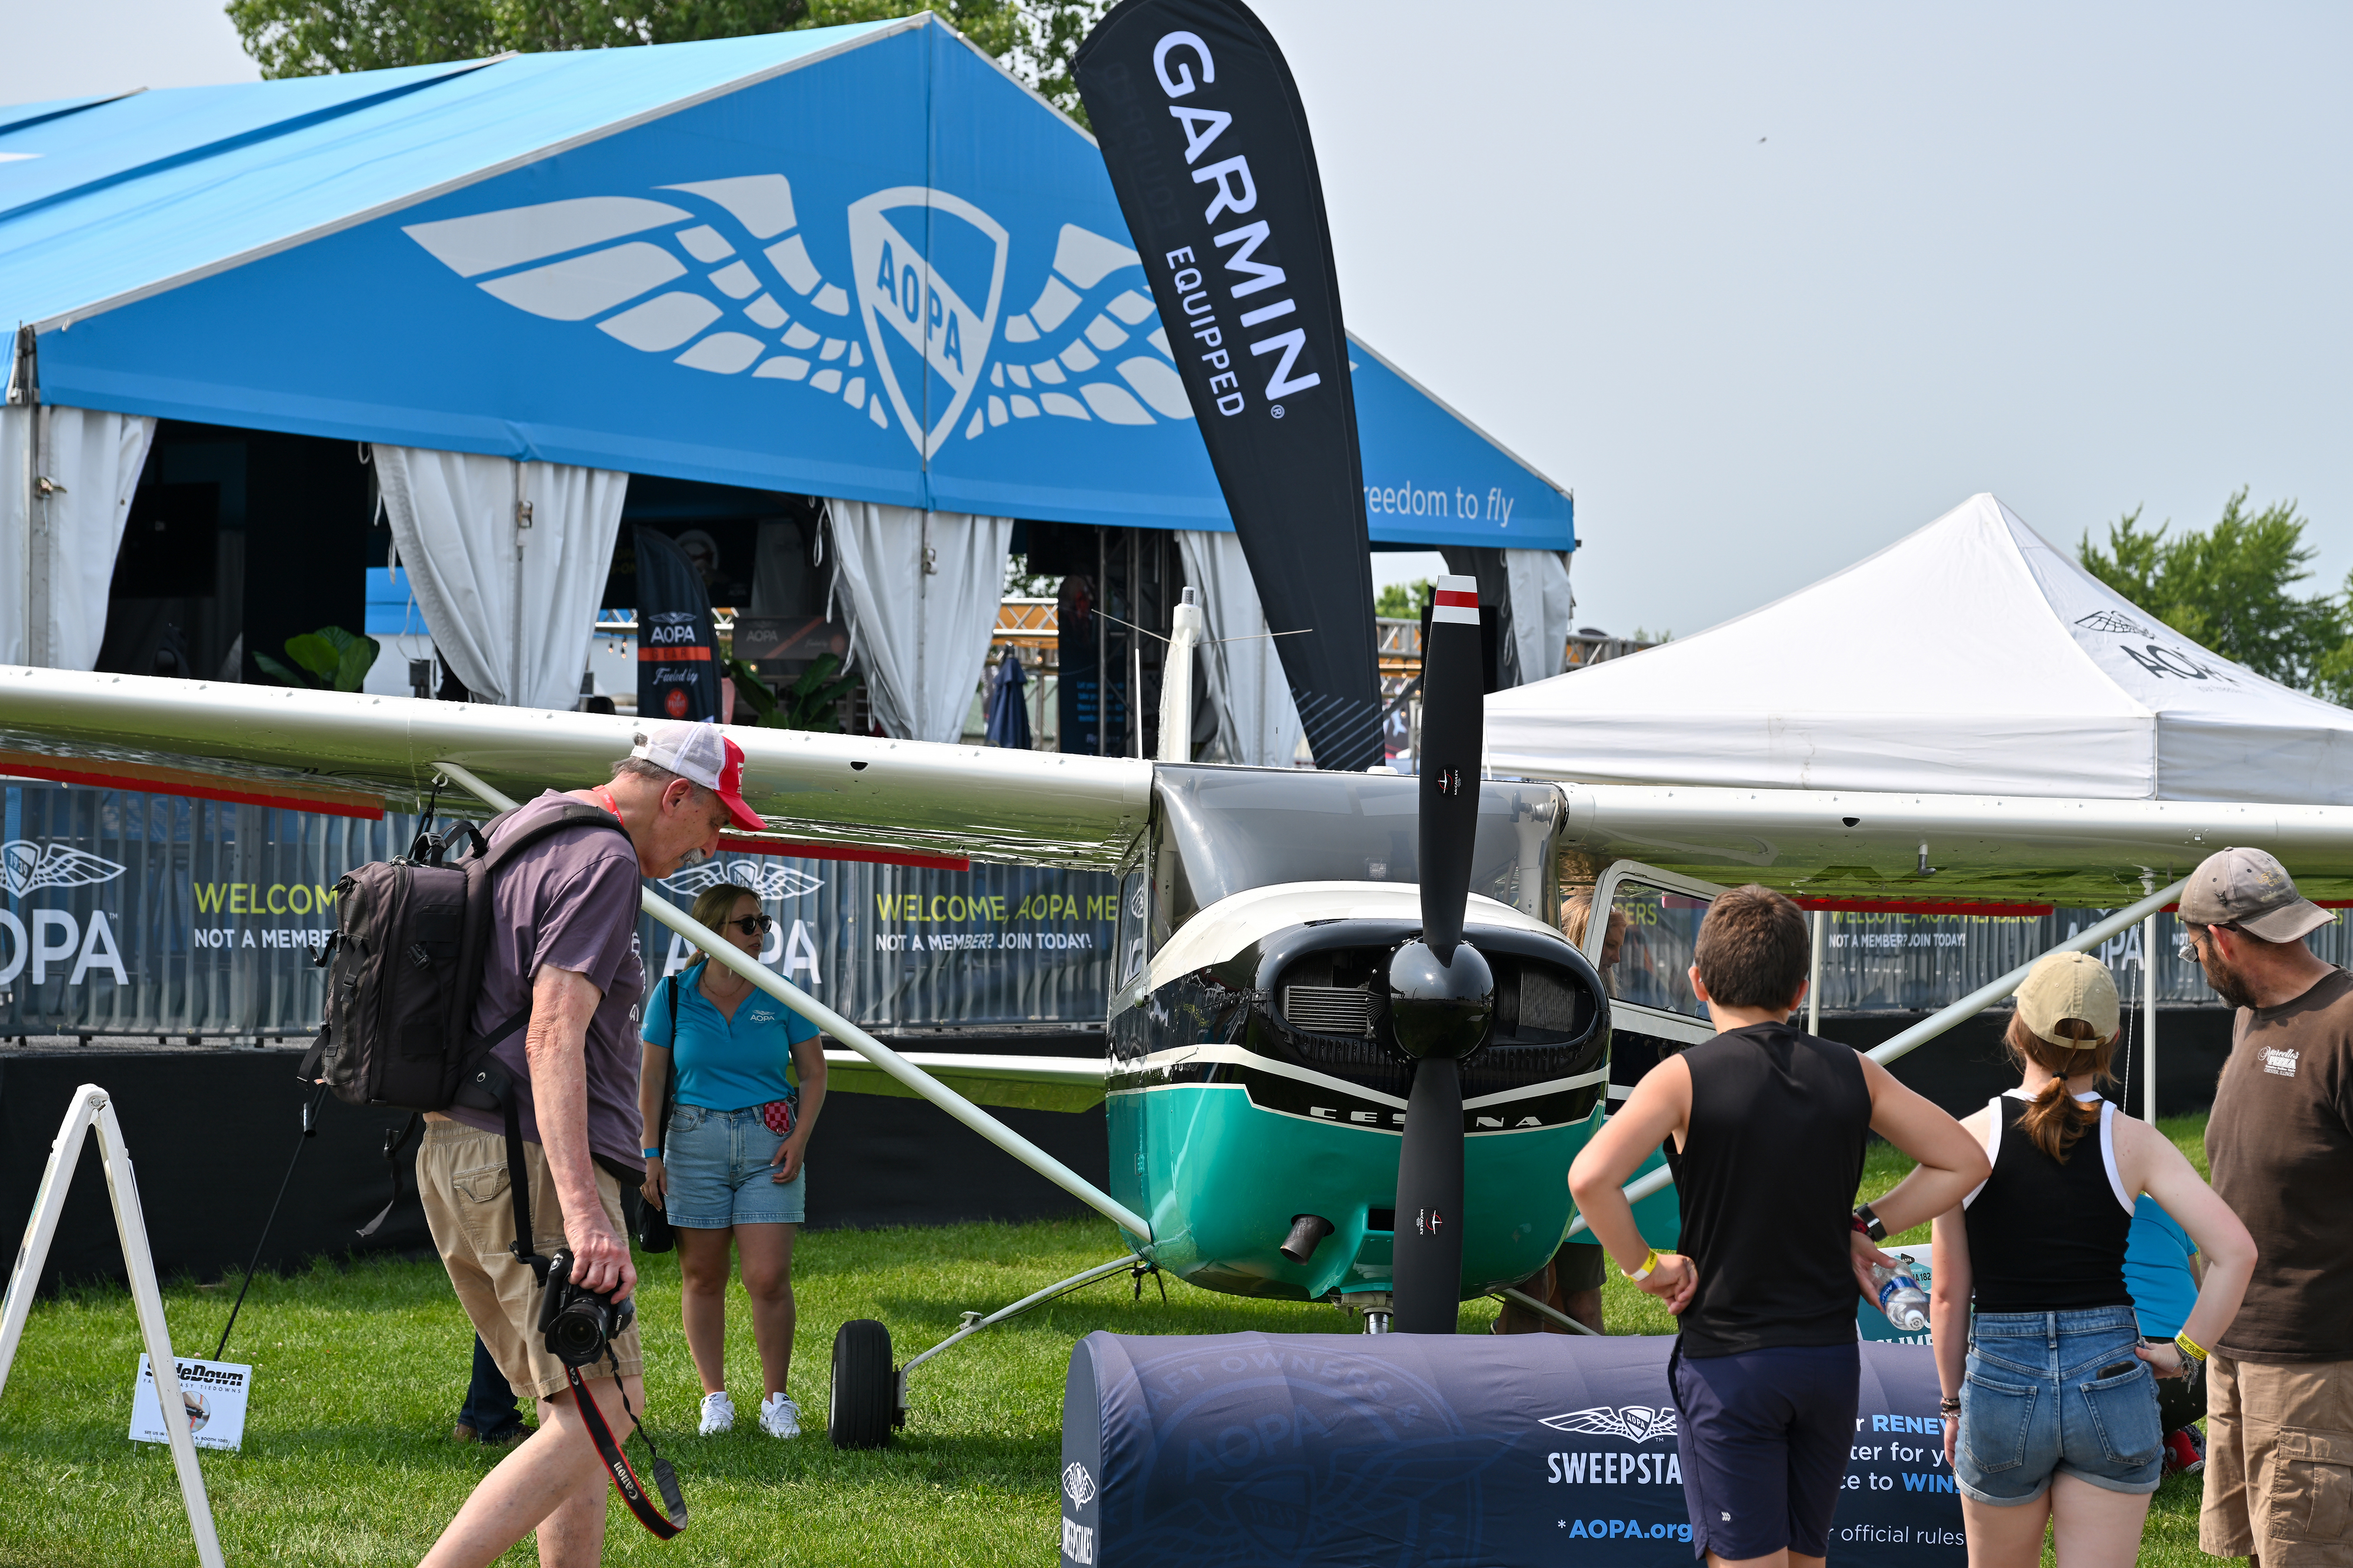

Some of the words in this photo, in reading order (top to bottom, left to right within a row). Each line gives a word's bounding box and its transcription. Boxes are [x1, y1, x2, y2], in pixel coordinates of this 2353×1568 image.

[1153, 31, 1321, 401] GARMIN
[876, 238, 965, 377] AOPA
[1166, 246, 1245, 416] EQUIPPED
[1364, 480, 1448, 518] eedom
[1456, 486, 1478, 520] to
[1486, 487, 1514, 528] fly
[650, 625, 696, 643] AOPA
[652, 648, 686, 659] GEAR
[652, 667, 684, 686] Fueled
[686, 668, 699, 685] by
[9, 853, 29, 877] 1939
[194, 882, 338, 914] WELCOM
[876, 893, 1009, 925] WELCOME,
[1015, 895, 1079, 920] AOPA
[0, 909, 129, 986] OPA
[194, 928, 234, 948] NOT
[242, 929, 255, 948] A
[262, 929, 338, 949] MEMBE
[876, 934, 908, 951] NOT
[912, 935, 925, 951] A
[928, 933, 993, 951] MEMBER?
[997, 933, 1032, 950] JOIN
[1036, 933, 1092, 949] TODAY!
[1829, 933, 1849, 948] NOT
[1851, 935, 1859, 948] A
[1861, 933, 1908, 948] MEMBER?
[1908, 933, 1931, 948] JOIN
[1934, 933, 1966, 948] TODAY!
[2268, 1056, 2296, 1069] PIZZA
[1920, 1272, 1932, 1281] 182
[2179, 1337, 2188, 1346] FREE
[2188, 1345, 2201, 1355] YOUTH
[1219, 1352, 1393, 1401] OWNERS
[200, 1384, 241, 1394] TIEDOWNS
[1627, 1413, 1646, 1429] AOPA
[1185, 1404, 1326, 1485] AOPA
[1850, 1446, 1882, 1460] ter
[1890, 1442, 1924, 1462] for
[1547, 1452, 1683, 1484] SWEEPSTA
[614, 1462, 638, 1500] Canon
[1868, 1472, 1894, 1491] to
[1061, 1516, 1093, 1565] SWEEPSTAKES
[1841, 1524, 1909, 1543] official
[1917, 1527, 1965, 1546] rules
